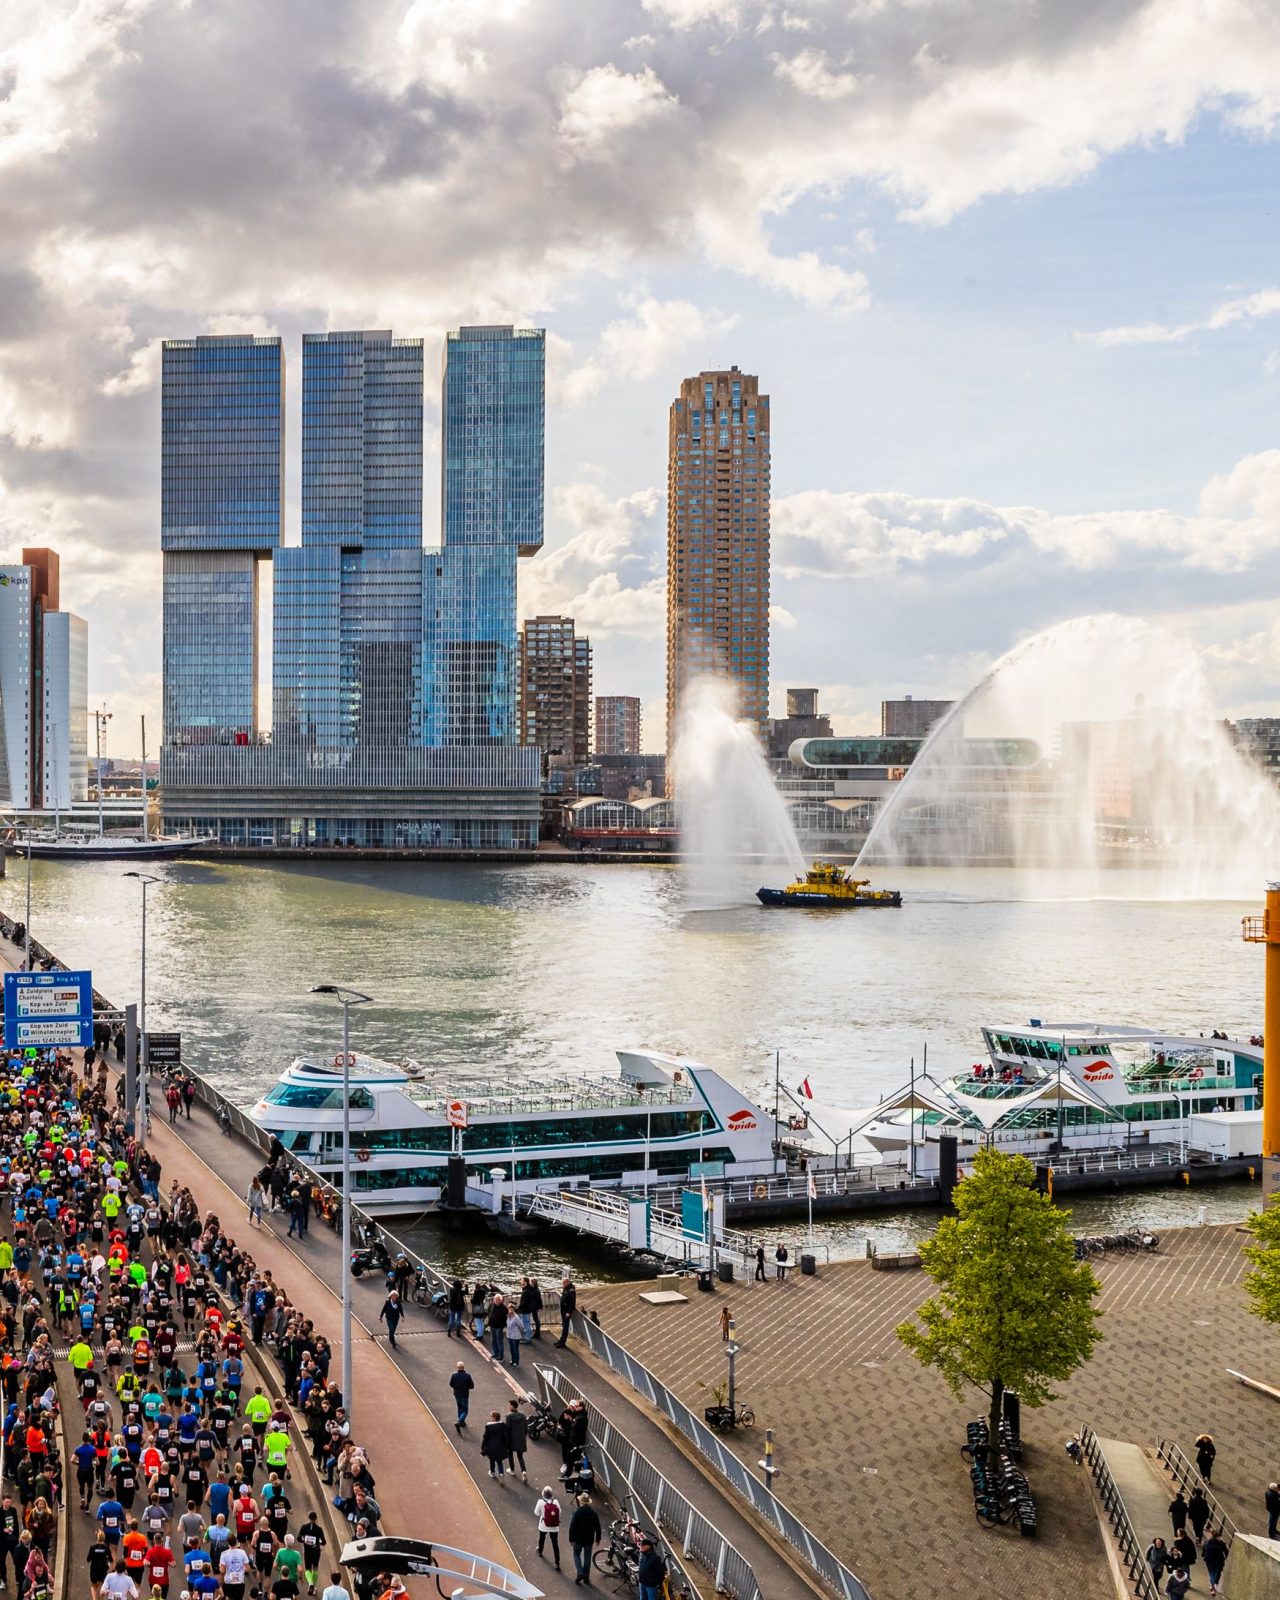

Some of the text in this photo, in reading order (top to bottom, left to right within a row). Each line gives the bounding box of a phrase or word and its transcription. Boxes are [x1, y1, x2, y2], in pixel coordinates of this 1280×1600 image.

[10, 576, 28, 585] kpn
[1083, 1072, 1114, 1082] Spido
[728, 1121, 757, 1131] Spido
